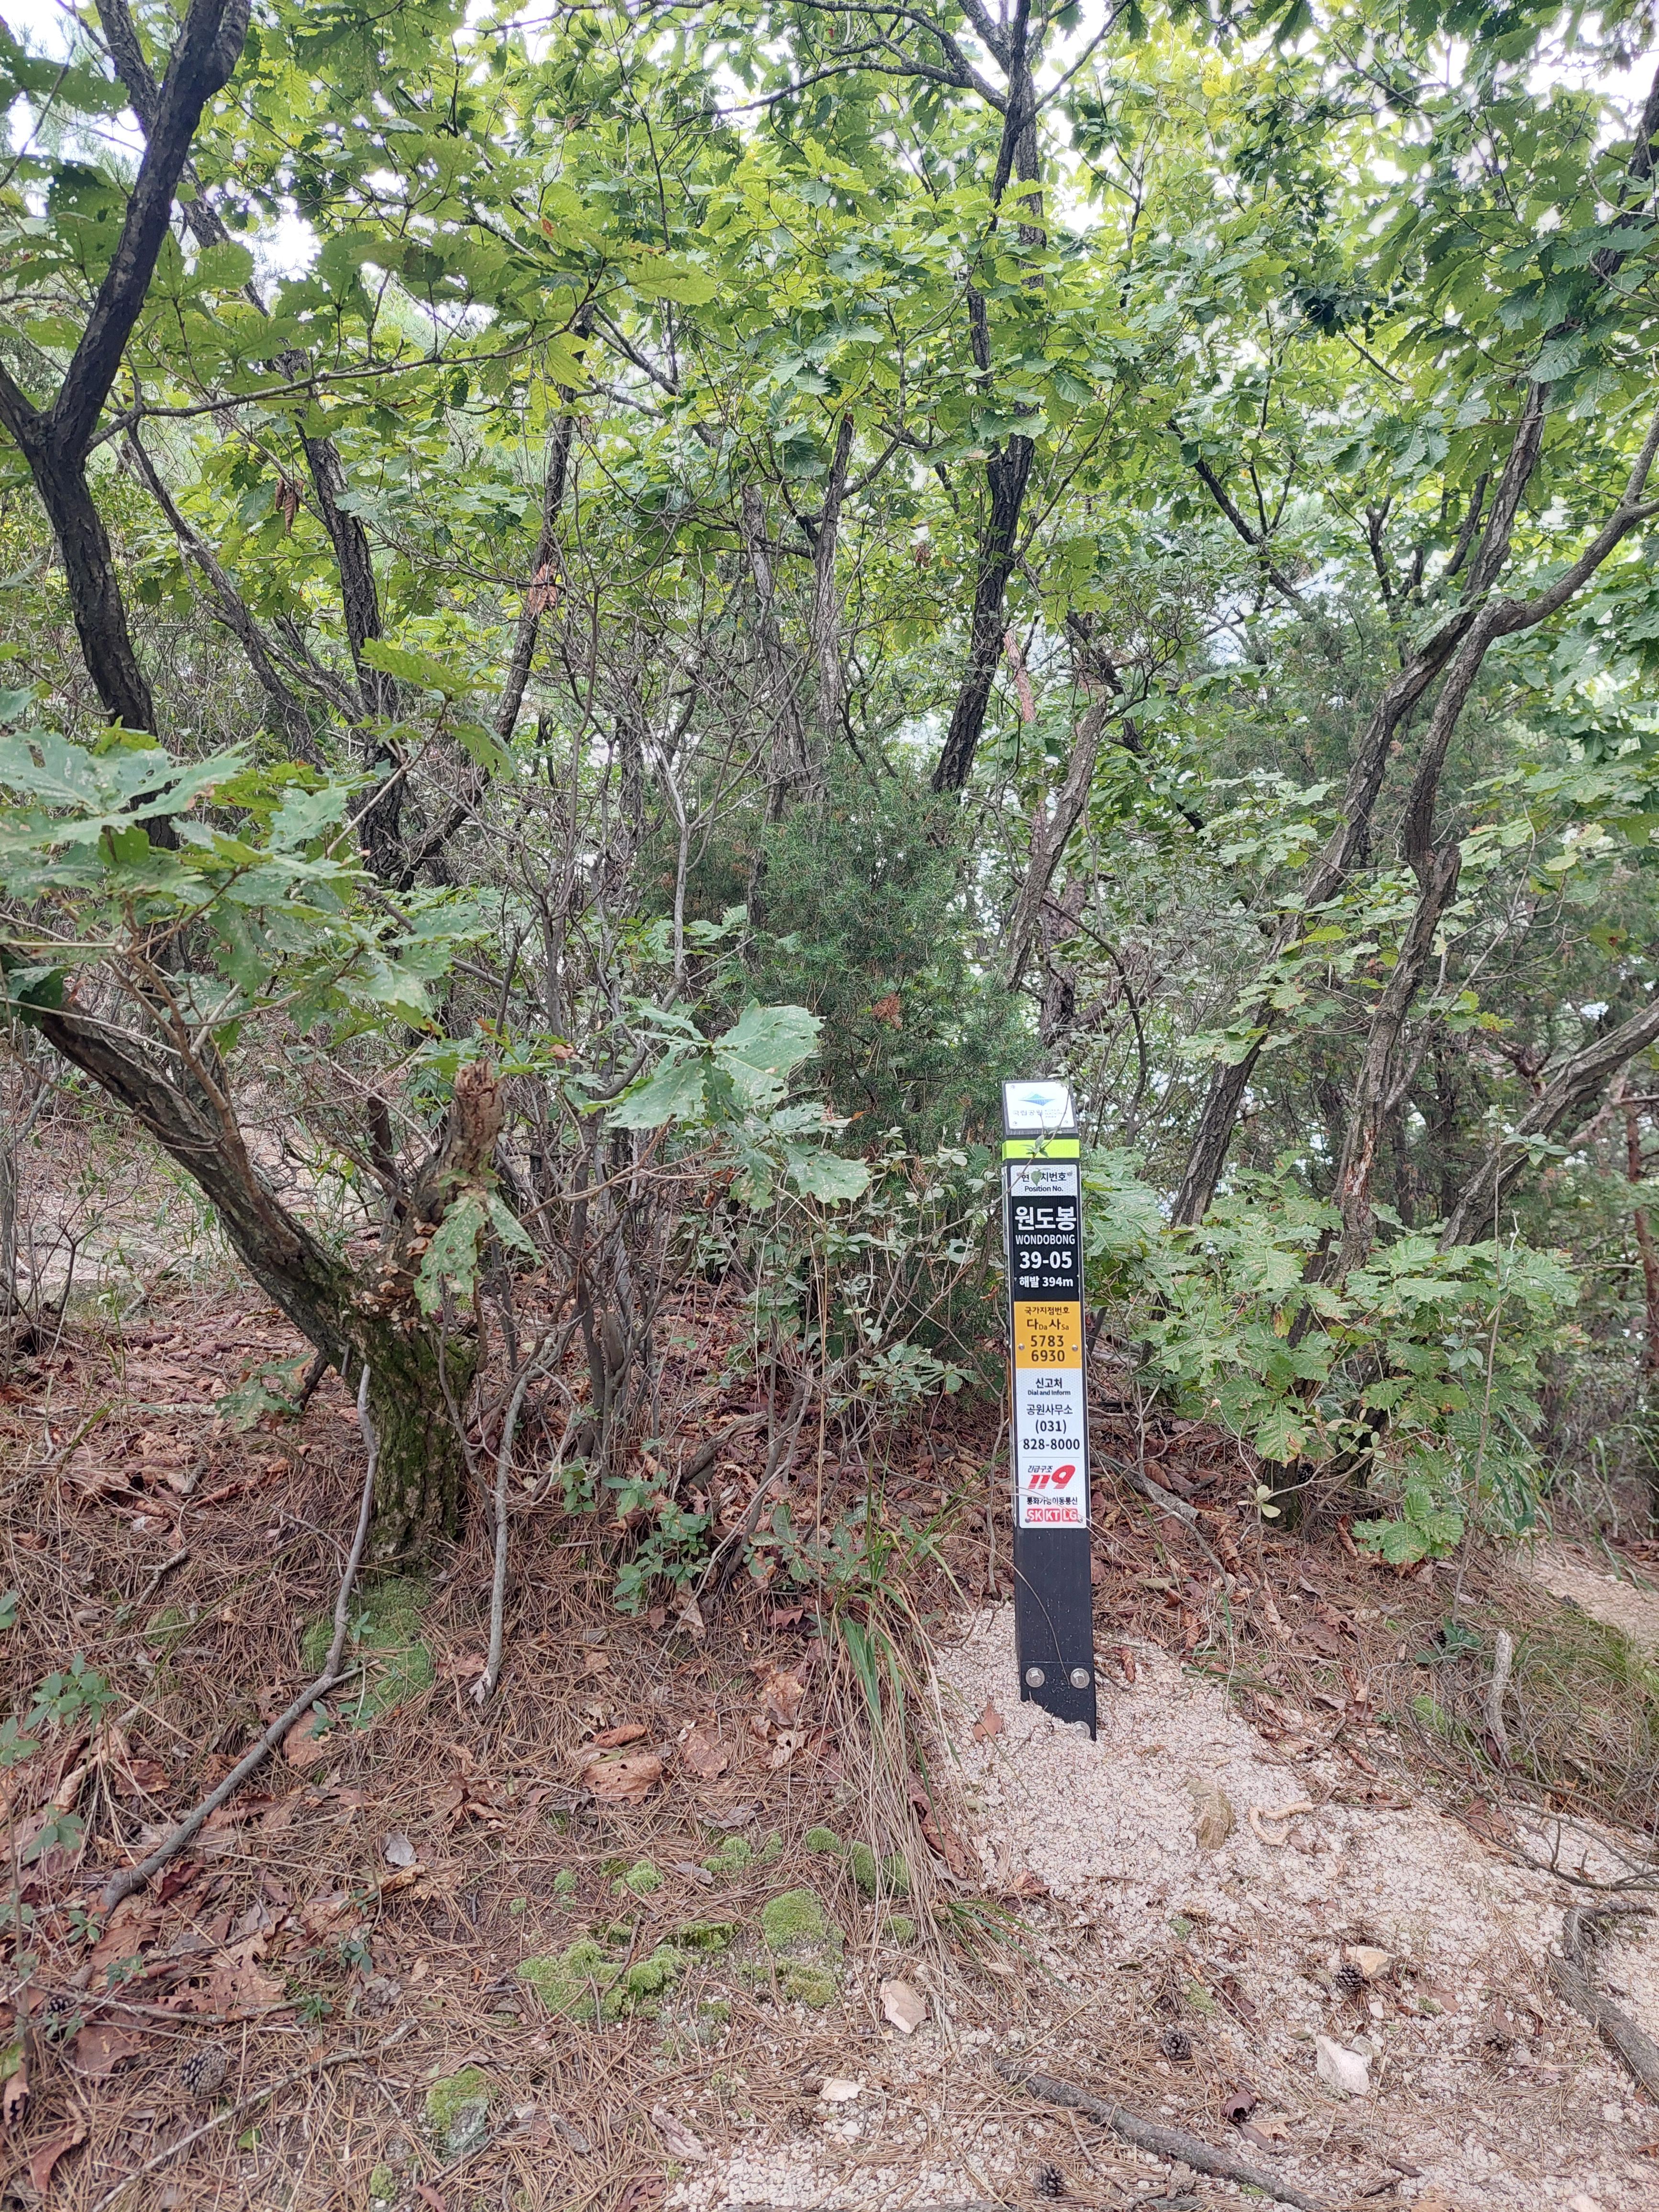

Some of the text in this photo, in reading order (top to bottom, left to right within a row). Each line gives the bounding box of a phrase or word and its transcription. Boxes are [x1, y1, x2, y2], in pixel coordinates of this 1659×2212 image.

[1015, 1206, 1077, 1231] 원도봉
[1015, 1234, 1075, 1245] WONDOBONG
[1019, 1251, 1073, 1269] 39-05
[1019, 1276, 1073, 1288] 해발 394m
[1024, 1306, 1070, 1316] 국가지점번호
[1030, 1335, 1064, 1347] 5783
[1031, 1350, 1065, 1362] 6930
[1036, 1378, 1063, 1389] 신고처
[1026, 1404, 1073, 1416] 공원사무소
[1035, 1419, 1067, 1434] (031)
[1023, 1438, 1080, 1450] 828-8000
[1028, 1464, 1076, 1490] 119
[1027, 1510, 1077, 1521] SK KT LG
